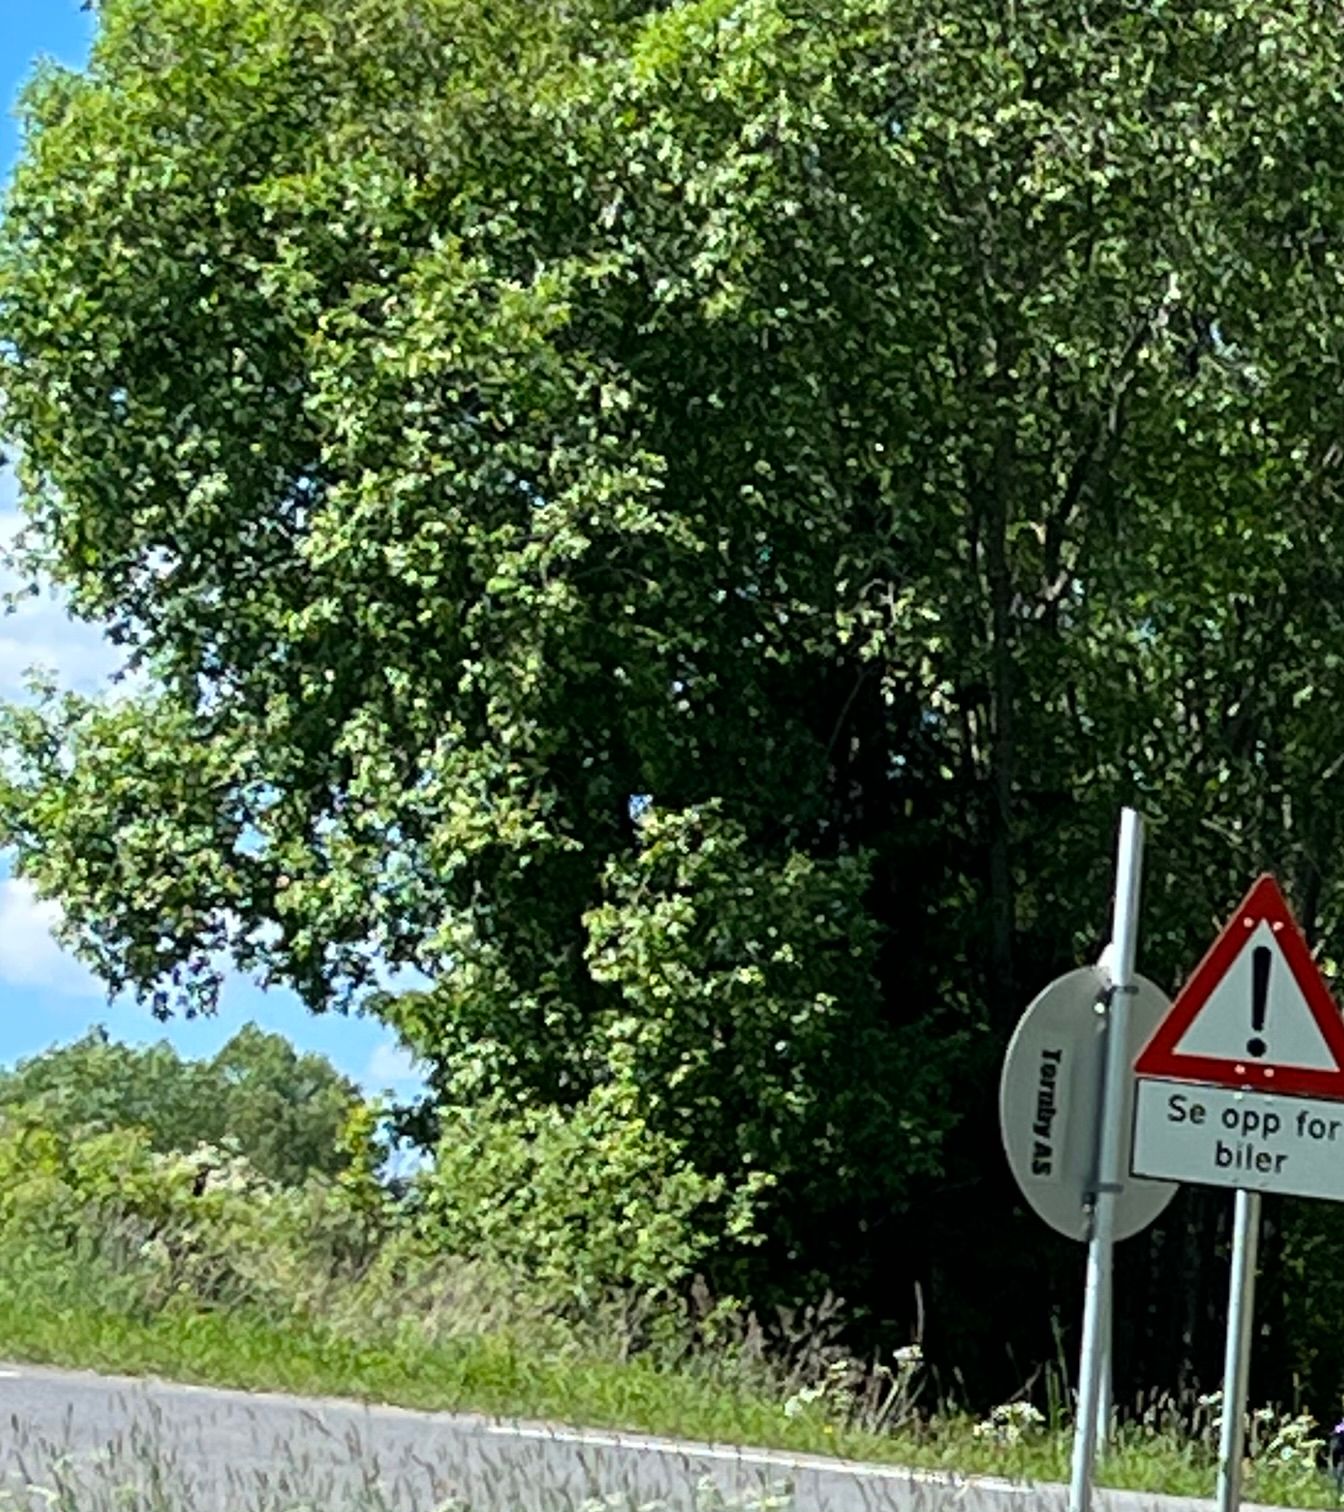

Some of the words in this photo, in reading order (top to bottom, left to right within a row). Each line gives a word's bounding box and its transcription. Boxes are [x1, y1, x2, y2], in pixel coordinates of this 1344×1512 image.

[1167, 1094, 1206, 1125] Se
[1221, 1107, 1281, 1140] opp
[1296, 1109, 1342, 1141] for
[1031, 1141, 1052, 1176] AS
[1214, 1140, 1288, 1173] biler
